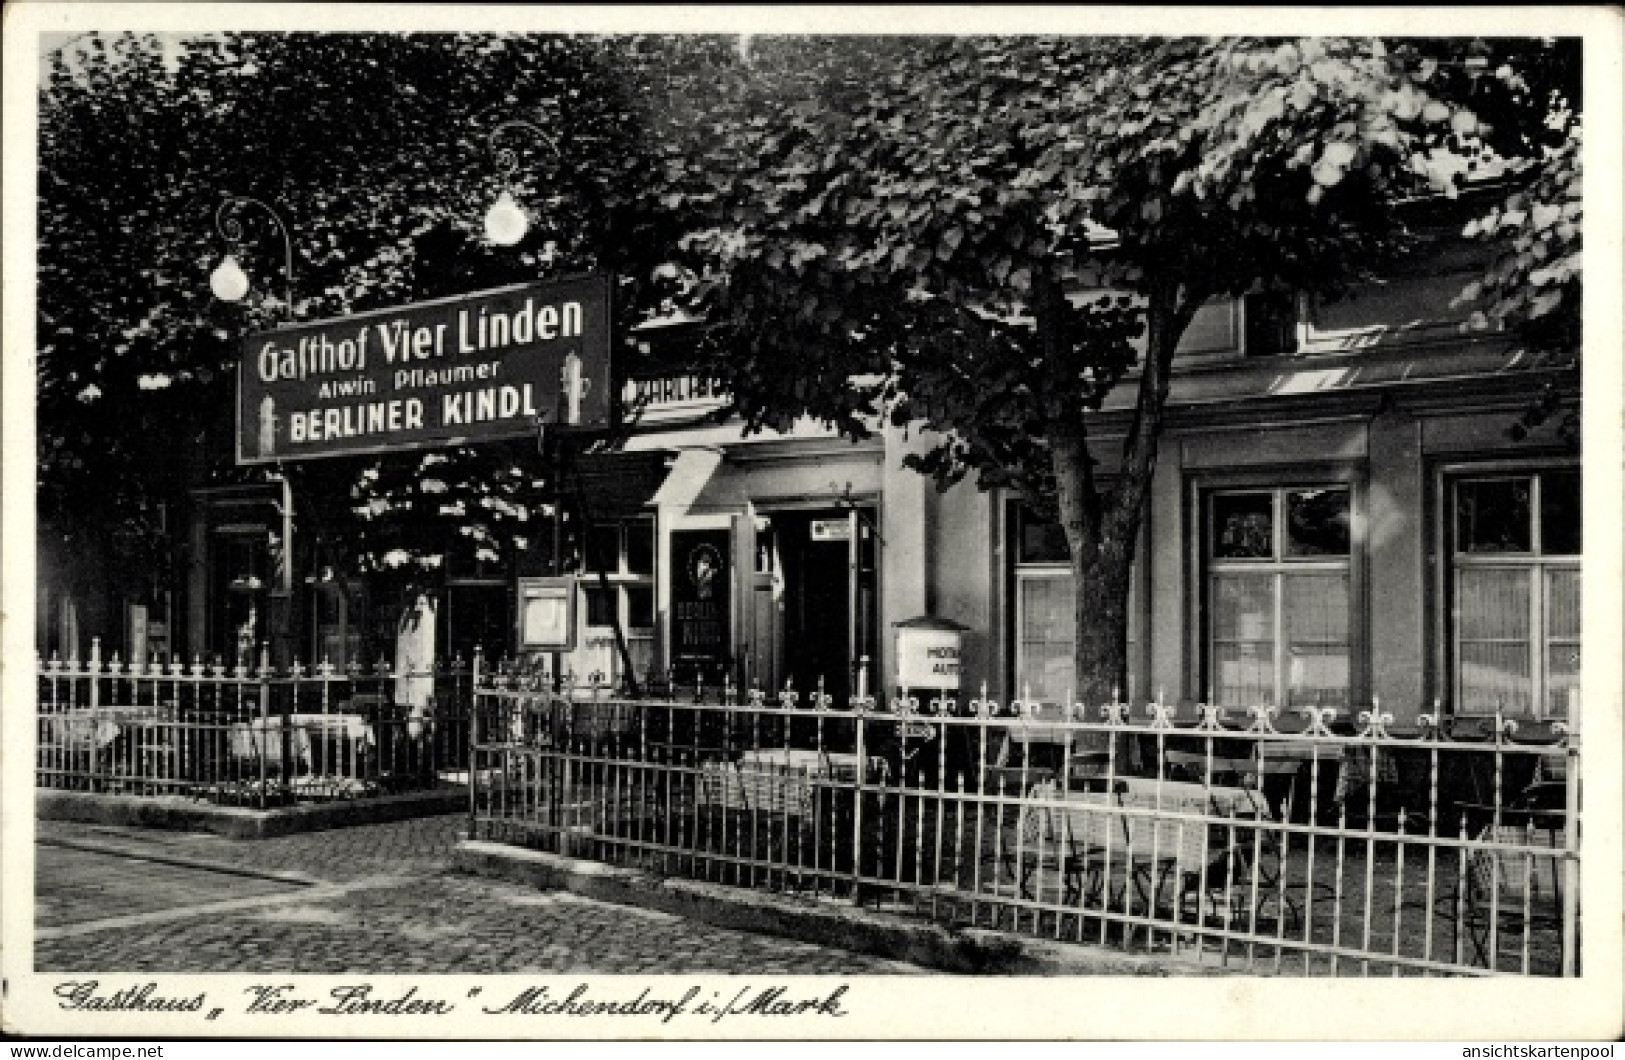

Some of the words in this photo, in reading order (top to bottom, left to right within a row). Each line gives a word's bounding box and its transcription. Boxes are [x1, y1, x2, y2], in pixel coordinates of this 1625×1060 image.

[376, 318, 448, 364] Vier
[458, 297, 584, 354] Linden
[290, 397, 424, 443] BERLINER
[443, 382, 536, 426] KINDL
[318, 374, 377, 399] Alwin
